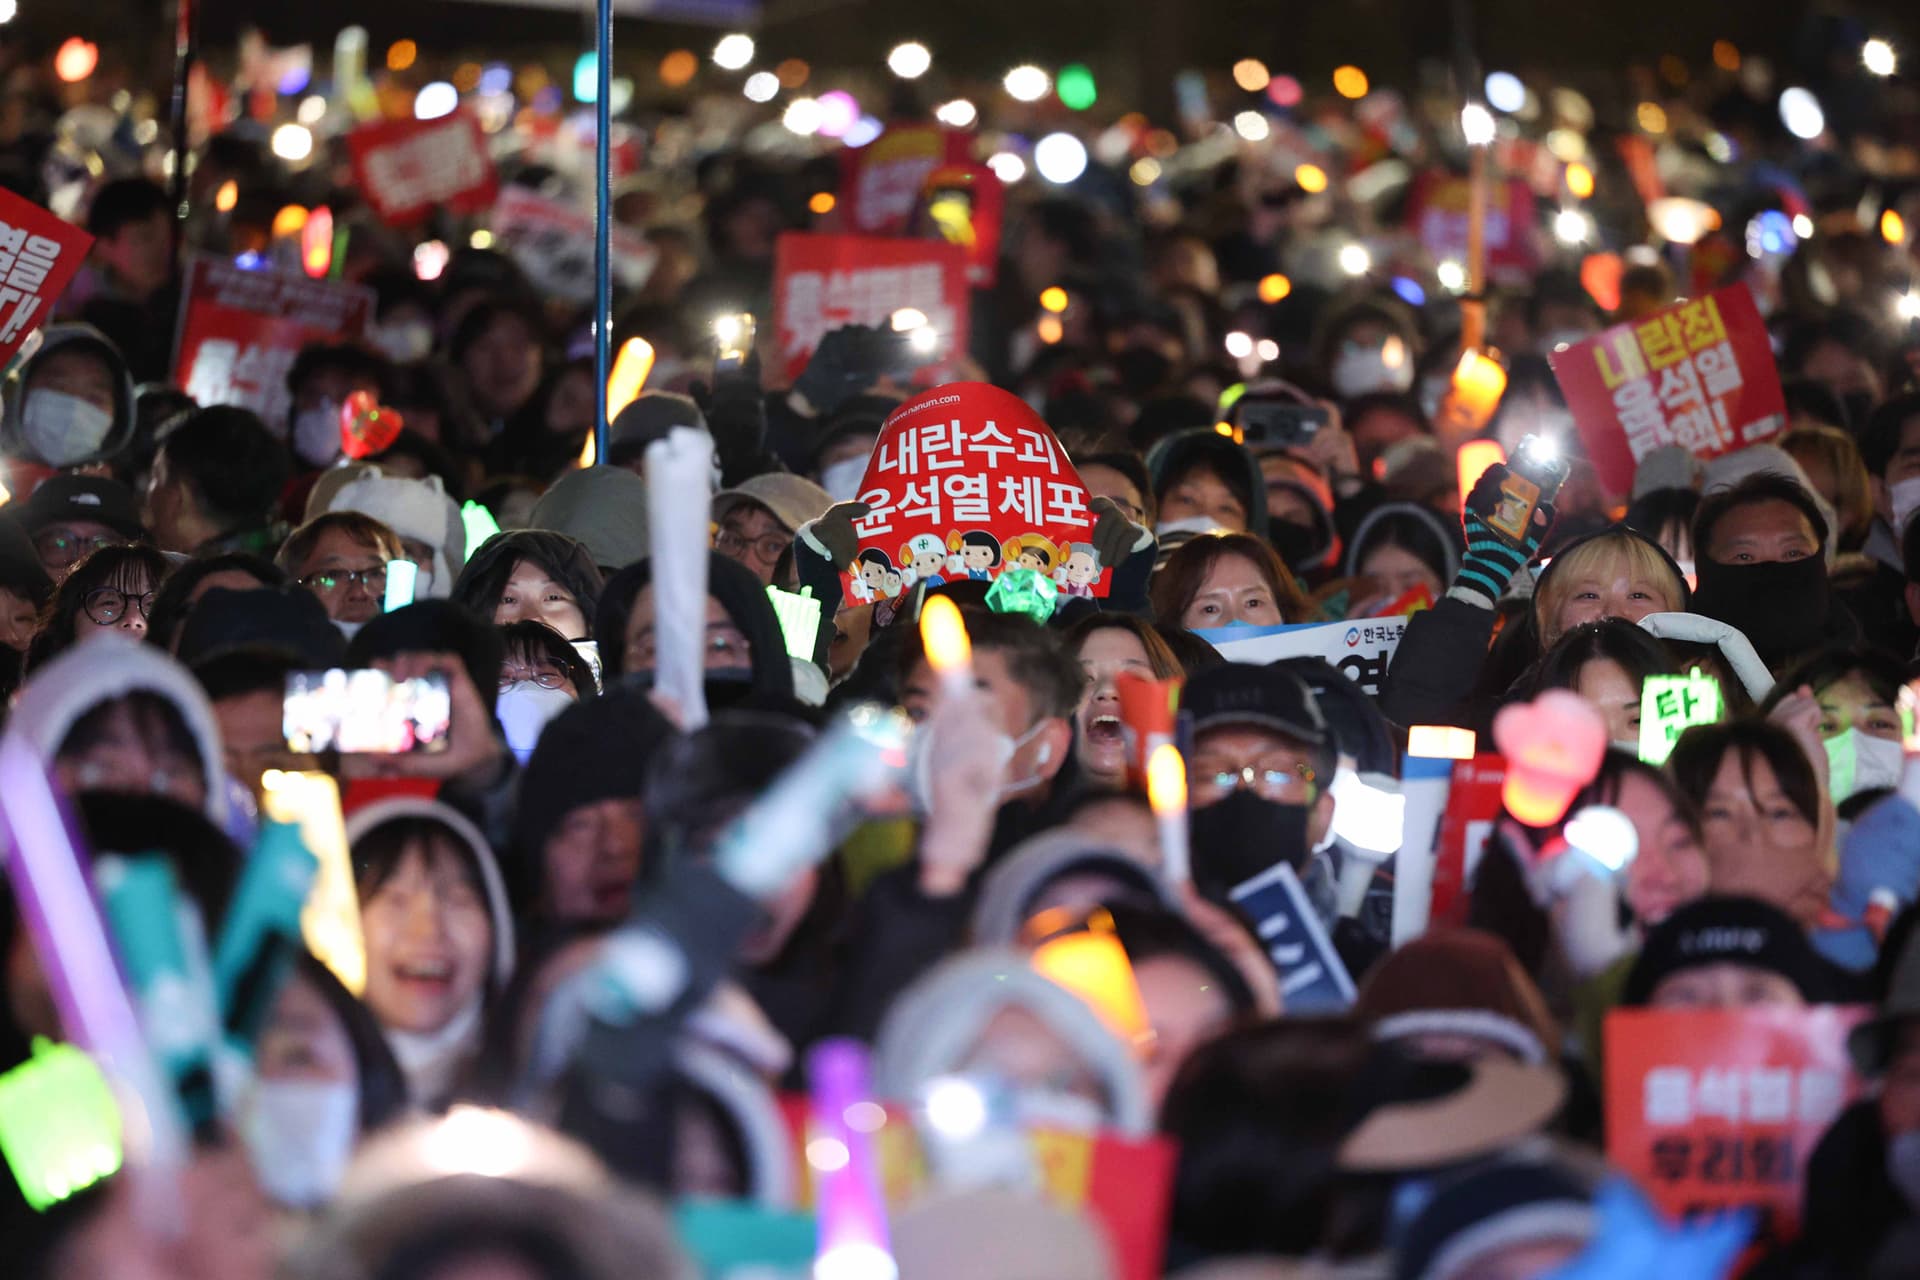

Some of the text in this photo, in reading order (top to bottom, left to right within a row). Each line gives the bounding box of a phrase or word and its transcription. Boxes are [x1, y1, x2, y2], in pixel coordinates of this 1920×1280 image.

[1593, 294, 1727, 390] 내란죄
[877, 419, 1059, 476] 내란수괴
[851, 472, 1089, 539] 윤석열 체포
